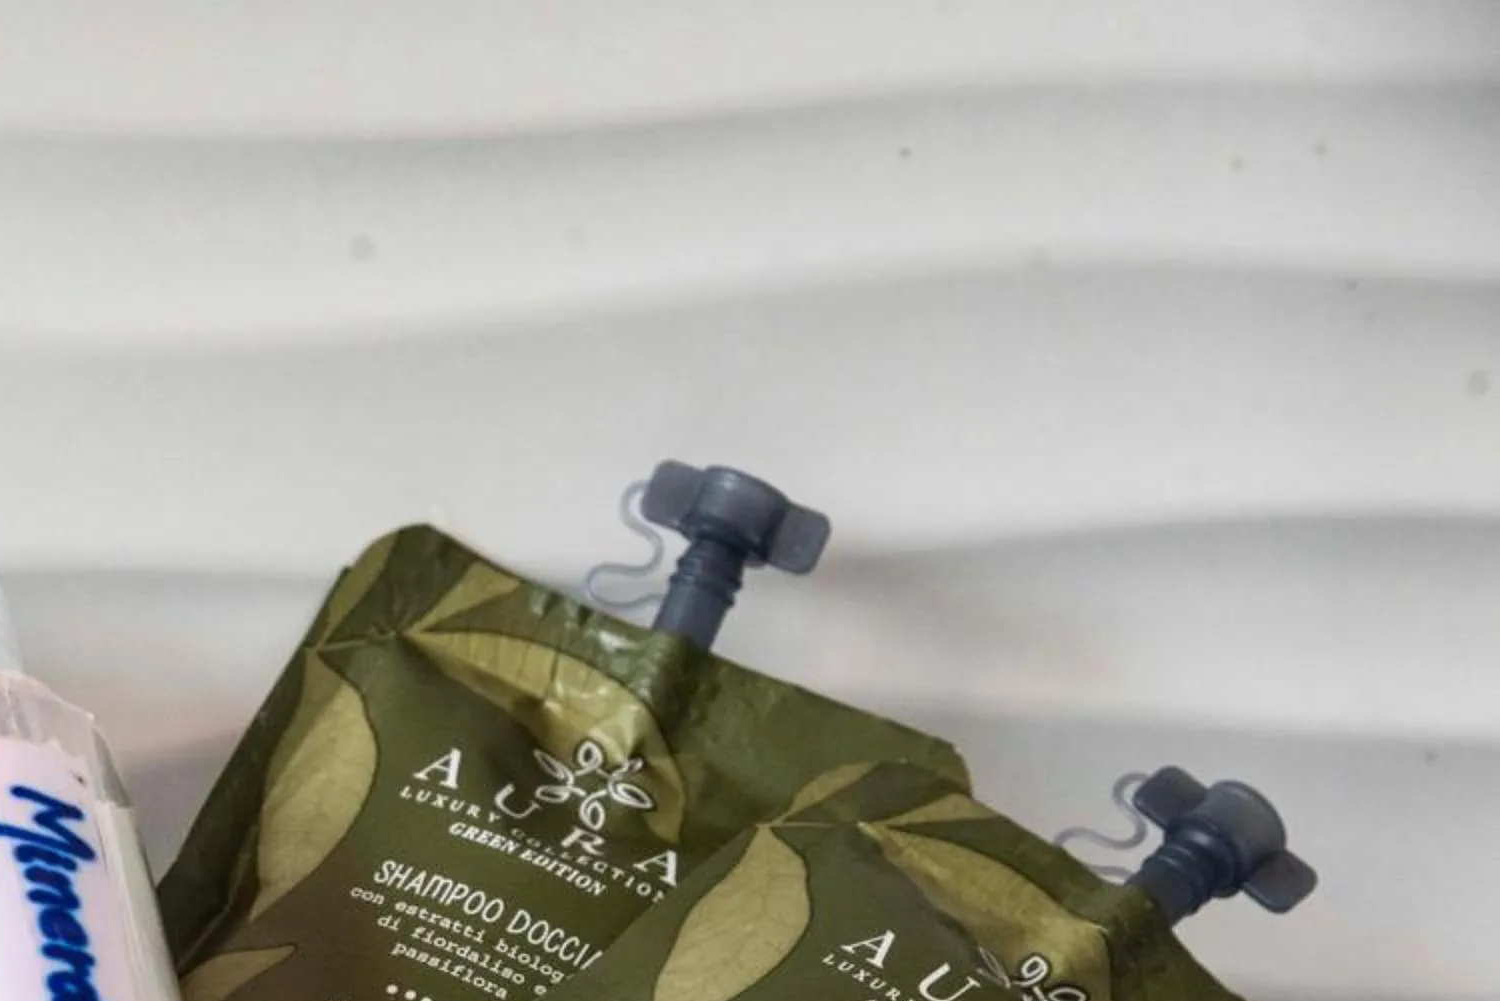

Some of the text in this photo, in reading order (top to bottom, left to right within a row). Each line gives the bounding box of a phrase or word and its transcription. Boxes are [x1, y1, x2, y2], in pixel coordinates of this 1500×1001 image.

[400, 785, 500, 823] LUXURY
[413, 747, 677, 887] AURA
[374, 859, 504, 923] SHAMPOO
[449, 822, 606, 896] GREEN EDITION
[349, 886, 574, 984] con estratti biolog
[377, 912, 547, 996] di fiordaliso e
[391, 941, 508, 1000] passiflora
